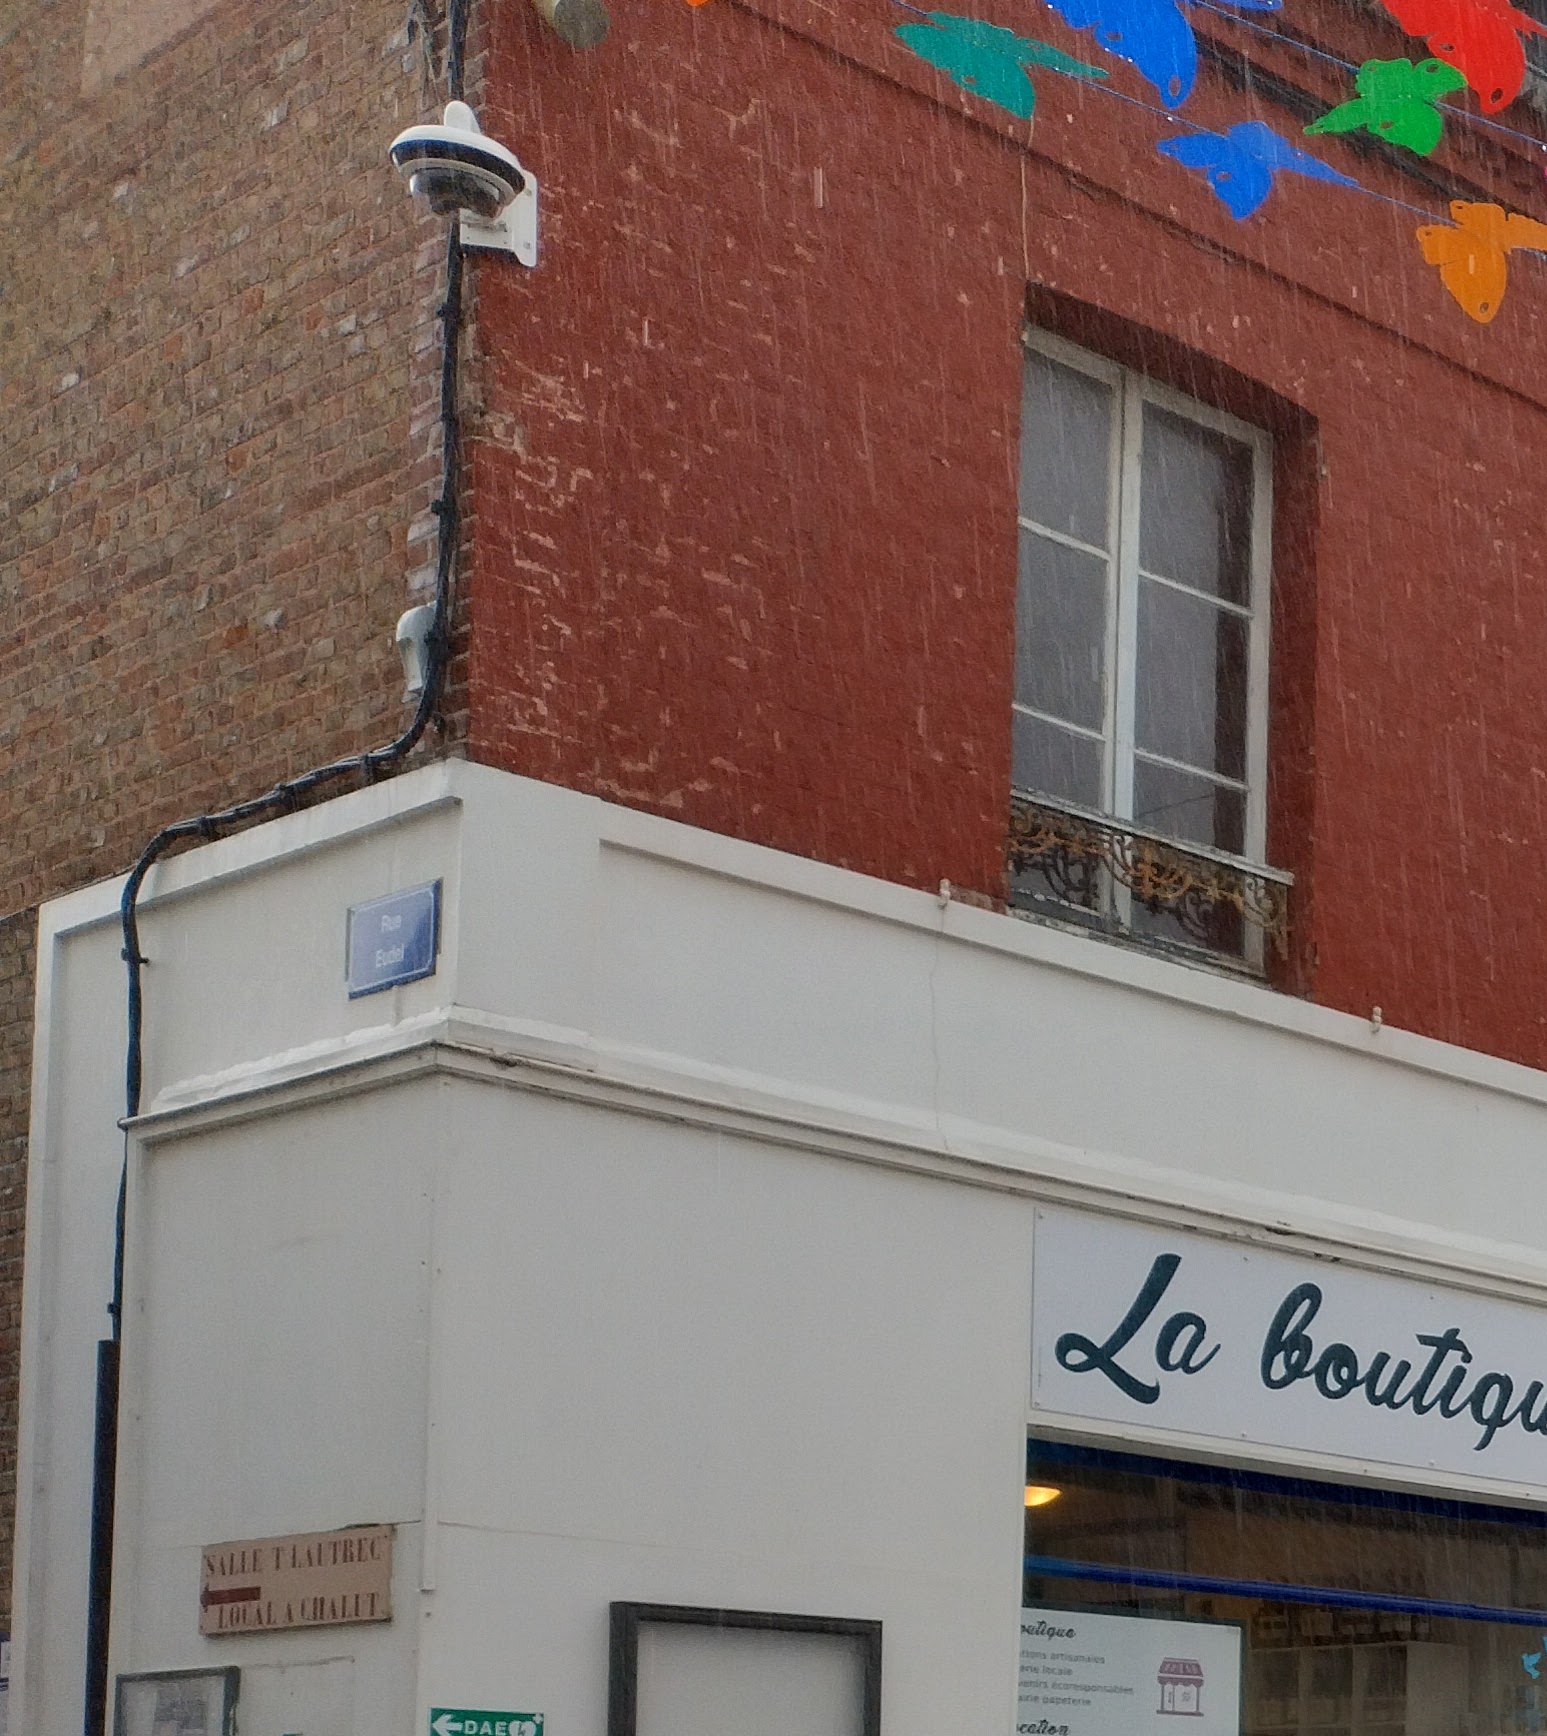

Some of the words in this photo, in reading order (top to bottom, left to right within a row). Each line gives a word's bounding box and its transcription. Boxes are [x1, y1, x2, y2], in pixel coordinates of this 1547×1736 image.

[1054, 1253, 1221, 1405] La
[205, 1548, 262, 1577] SALLE
[290, 1535, 382, 1569] LAUTREC
[218, 1601, 277, 1629] LOCAL
[300, 1592, 380, 1621] CHALUT
[464, 1719, 508, 1736] DAE
[1016, 1719, 1071, 1736] cation
